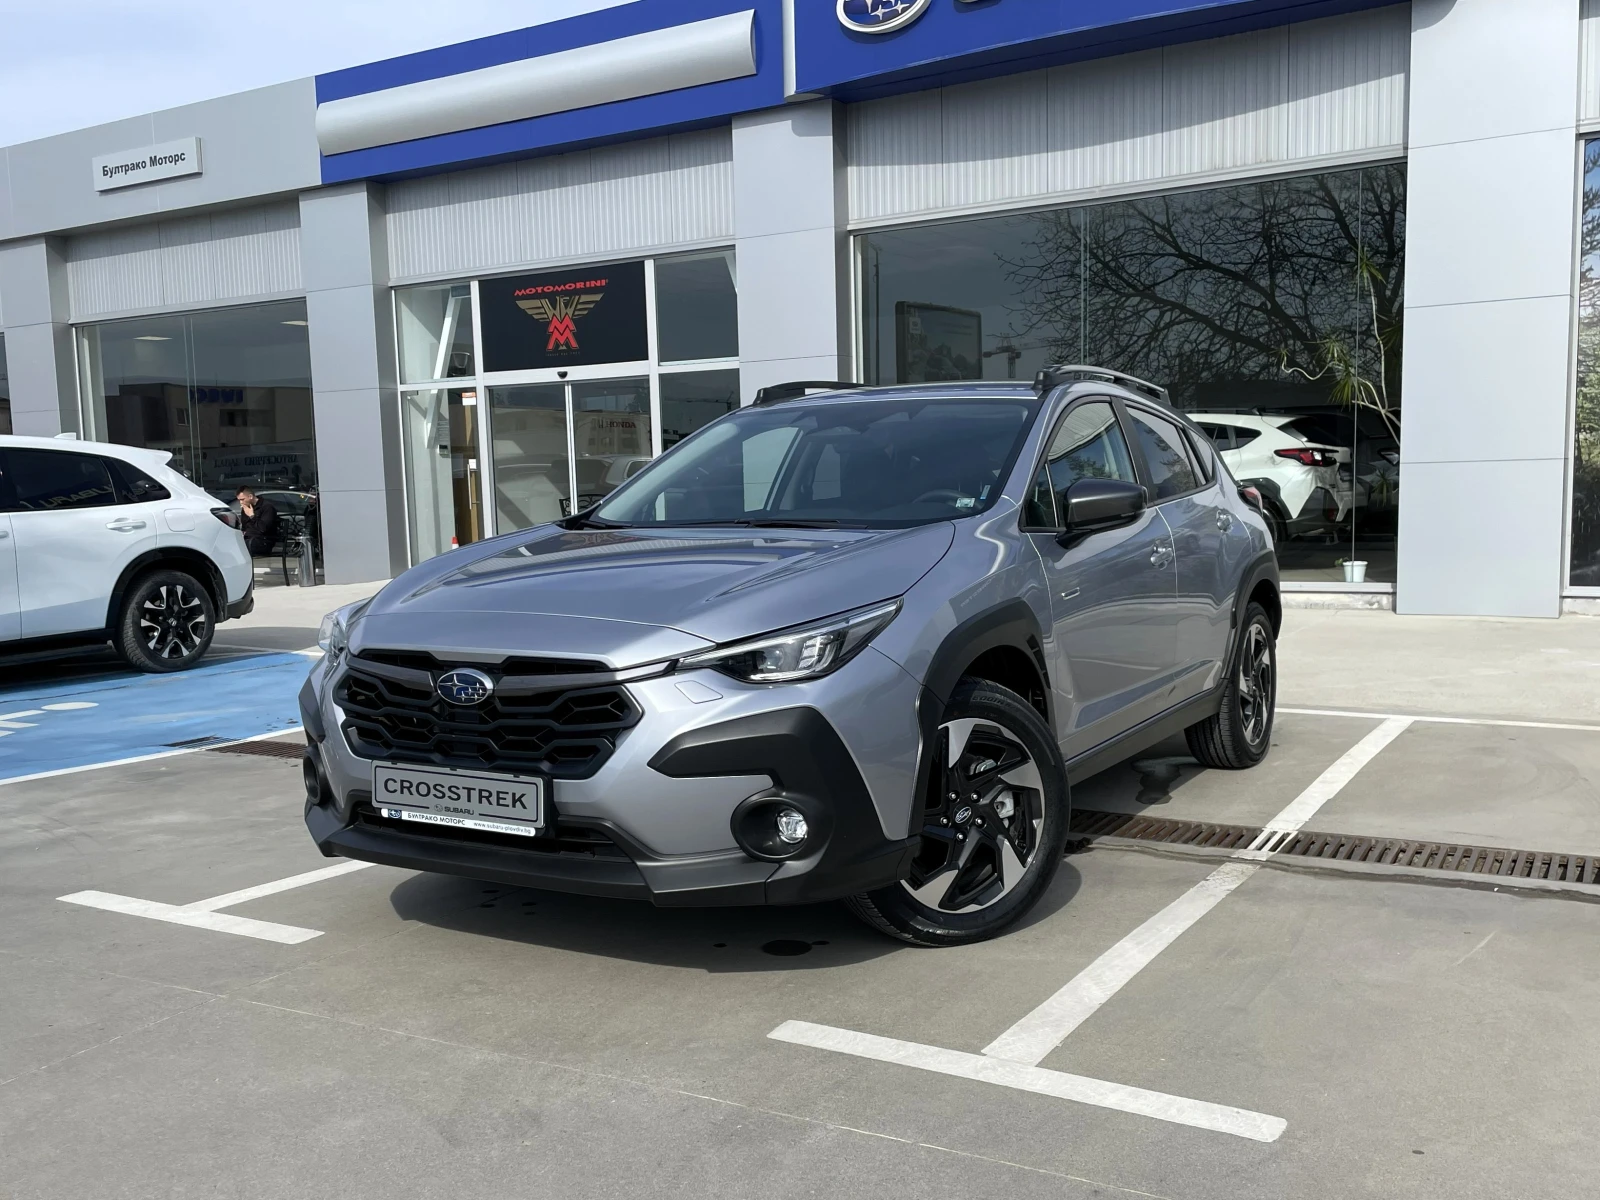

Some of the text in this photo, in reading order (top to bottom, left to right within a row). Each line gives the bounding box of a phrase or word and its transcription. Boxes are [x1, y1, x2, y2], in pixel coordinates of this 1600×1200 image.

[102, 152, 186, 178] Бултрако Моторс
[606, 420, 637, 429] HONDA
[383, 777, 528, 810] CROSSTREK
[444, 806, 475, 816] SUBARU
[407, 812, 466, 827] БУЛТРАКО МОТОРС
